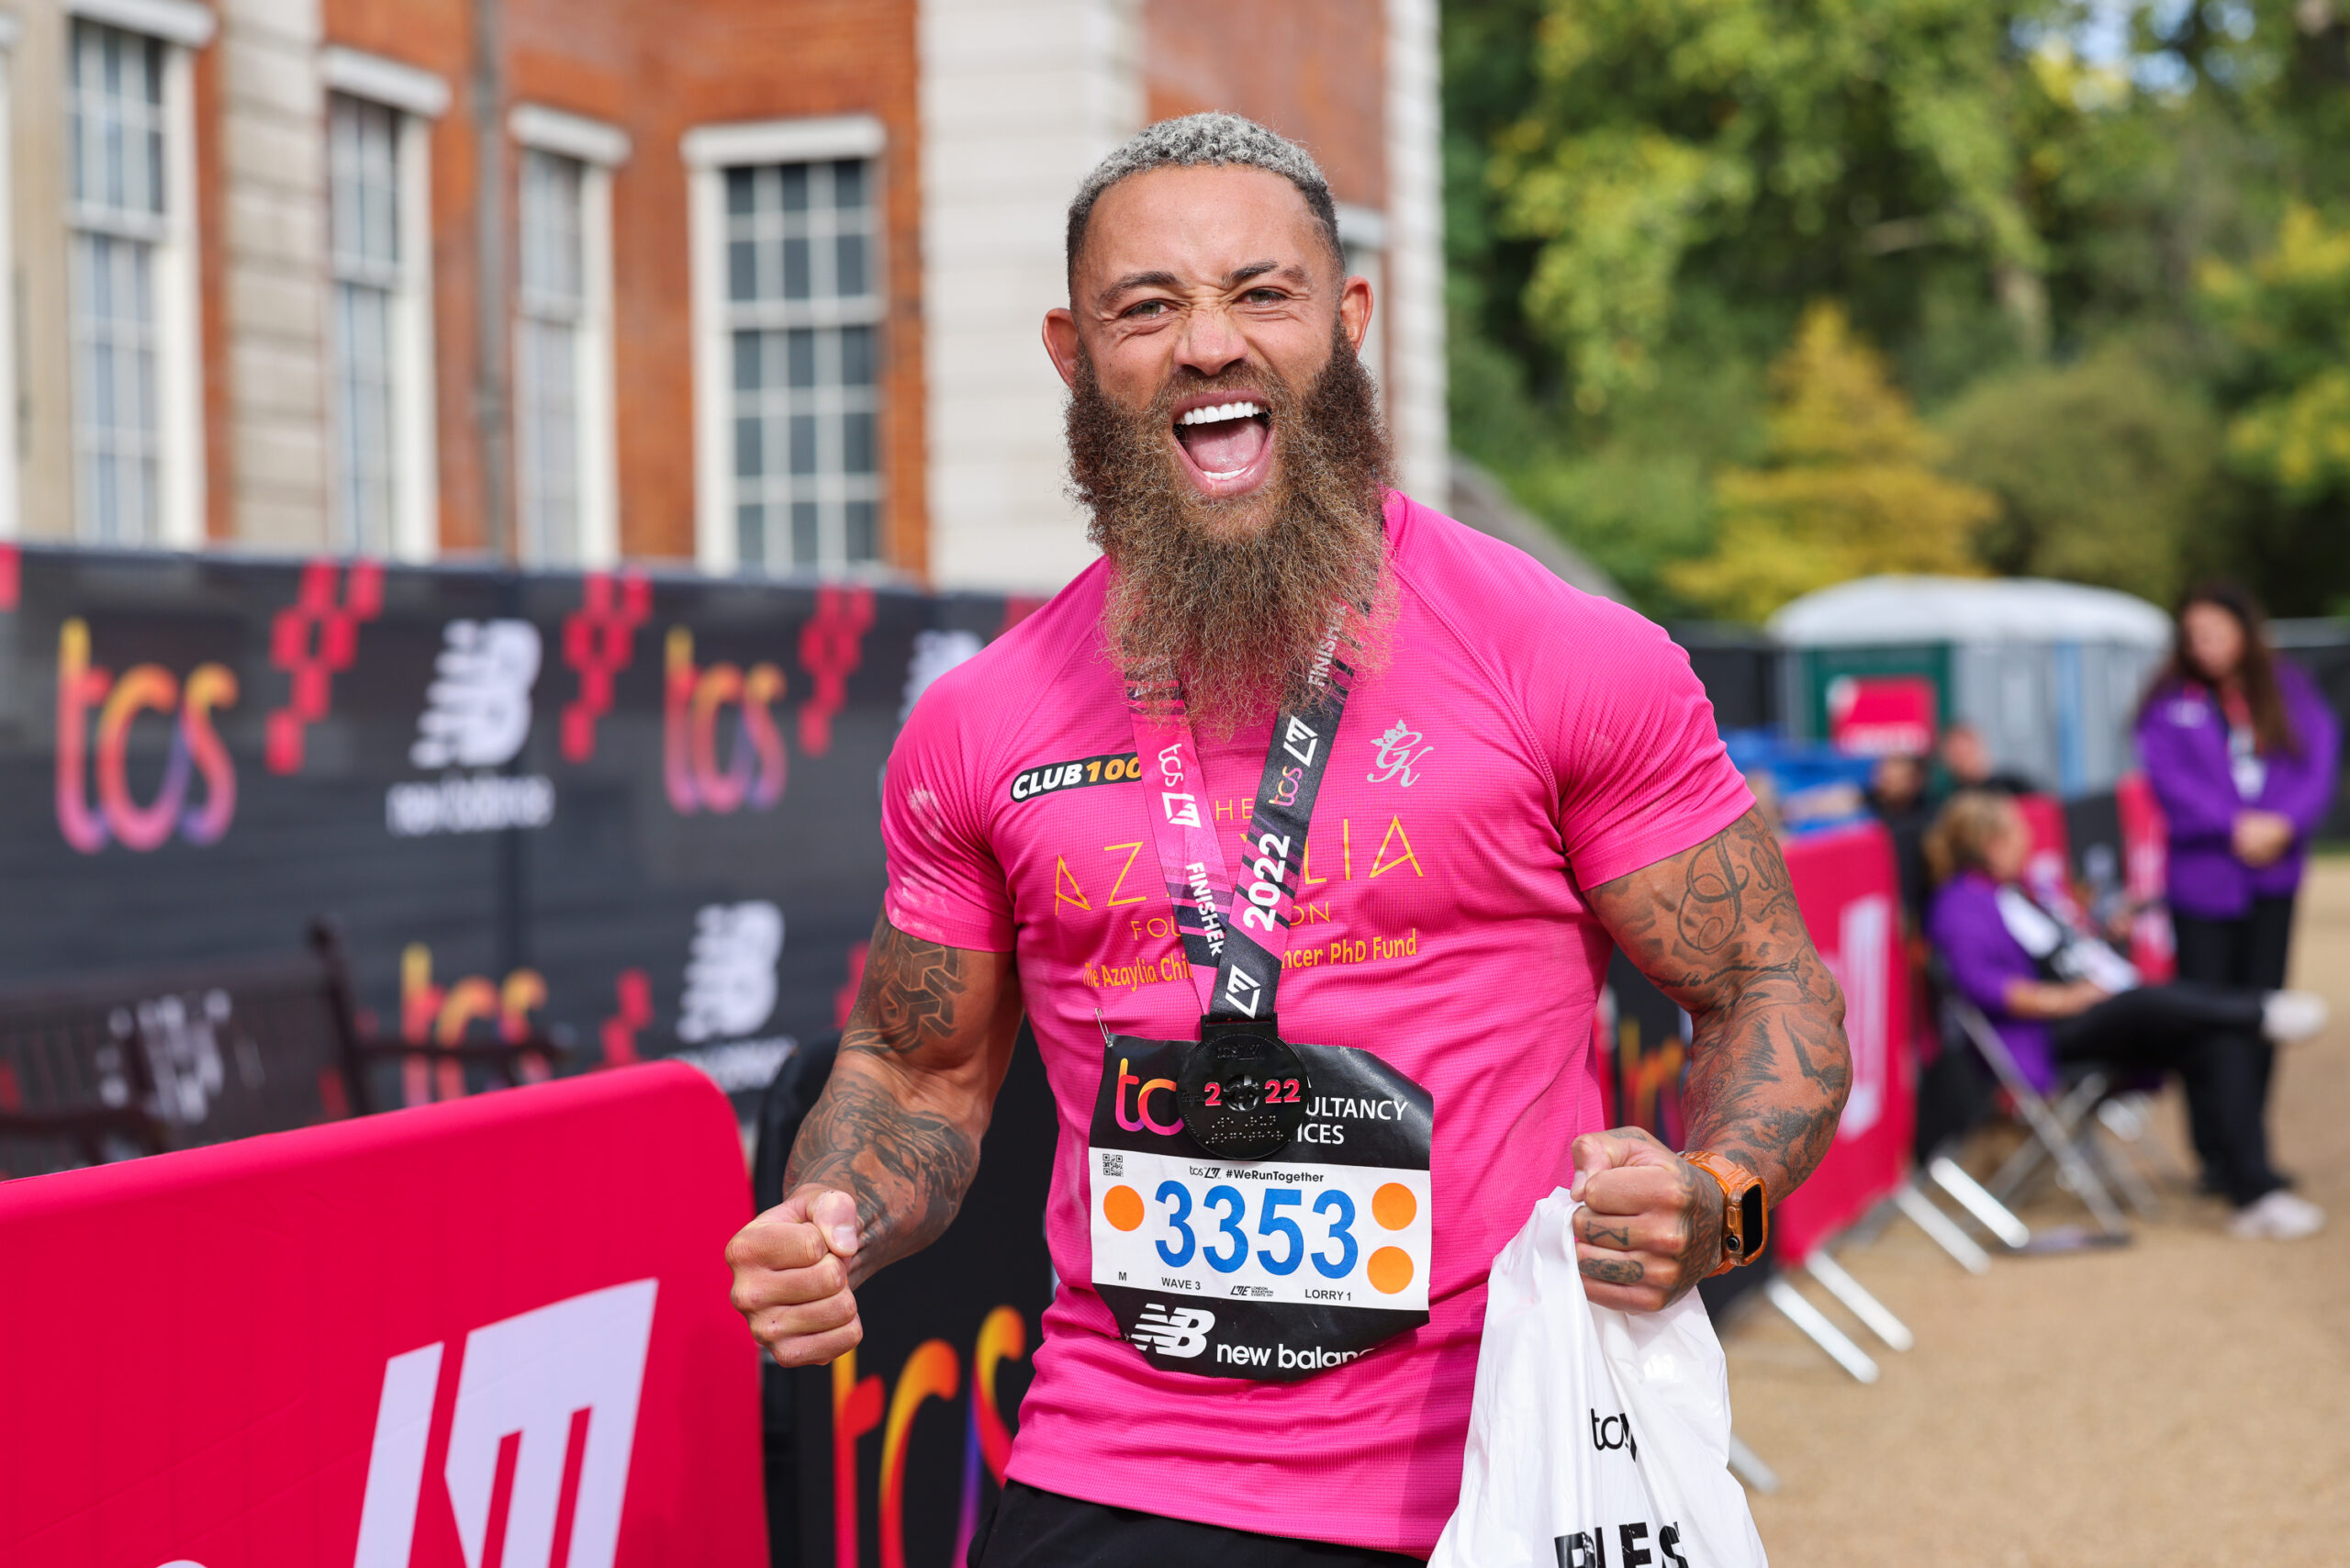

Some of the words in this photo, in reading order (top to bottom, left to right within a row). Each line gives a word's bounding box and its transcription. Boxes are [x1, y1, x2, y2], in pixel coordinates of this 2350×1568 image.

[57, 617, 239, 854] tcs
[665, 626, 787, 814] tcs
[1158, 743, 1184, 788] tcs
[1268, 765, 1303, 807] tcs
[1214, 797, 1254, 821] HE
[1054, 813, 1424, 916] AZLIA
[1243, 833, 1291, 932] 2022
[1102, 958, 1158, 992] Azaylia
[1281, 947, 1324, 969] ncer
[1331, 939, 1366, 965] PhD
[1372, 928, 1417, 960] Fund
[1115, 1058, 1185, 1137] tc
[1305, 1096, 1410, 1121] ULTANCY
[1297, 1123, 1345, 1145] ICES
[1189, 1165, 1203, 1176] tcs
[1225, 1169, 1325, 1183] #WeRunTogether
[1155, 1180, 1359, 1279] 3353
[1118, 1271, 1127, 1282] M
[1161, 1277, 1192, 1290] WAVE
[1195, 1281, 1202, 1291] 3
[1304, 1288, 1344, 1301] LORRY
[1347, 1292, 1352, 1302] 1
[1216, 1343, 1272, 1367] new
[1278, 1343, 1376, 1370] balan
[1590, 1407, 1625, 1451] tc
